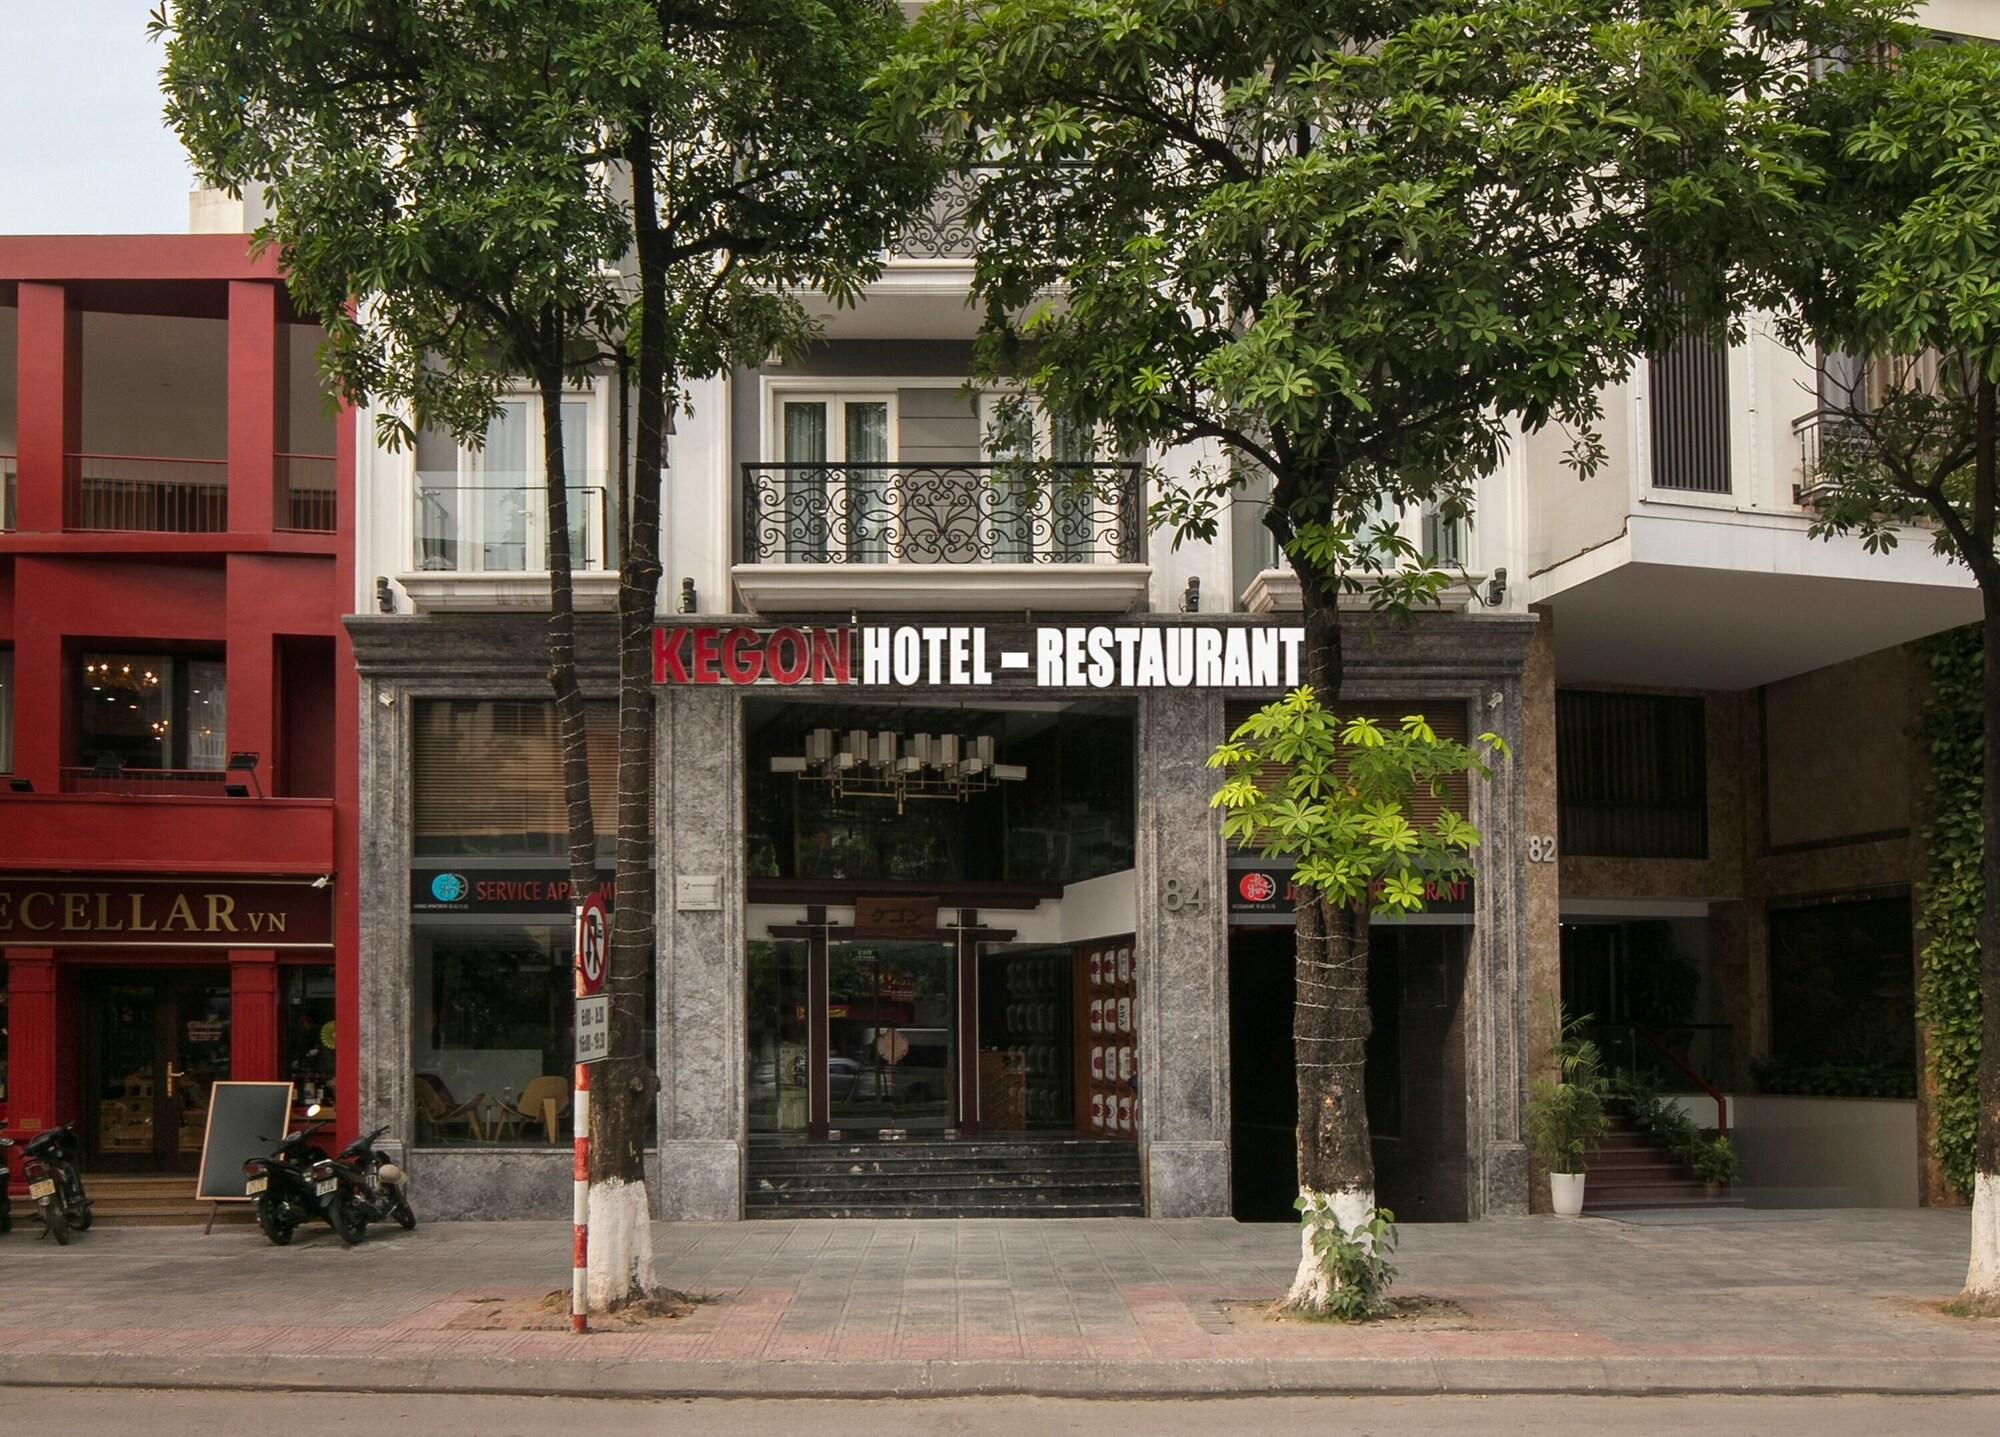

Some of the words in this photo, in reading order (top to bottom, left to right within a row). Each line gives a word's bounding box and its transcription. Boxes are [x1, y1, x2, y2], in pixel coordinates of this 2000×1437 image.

[652, 626, 850, 686] KEGON
[863, 626, 992, 686] HOTEL
[1037, 626, 1305, 688] RESTAURANT
[1529, 835, 1556, 863] 82
[476, 881, 541, 900] SERVICE
[1162, 878, 1208, 912] 84
